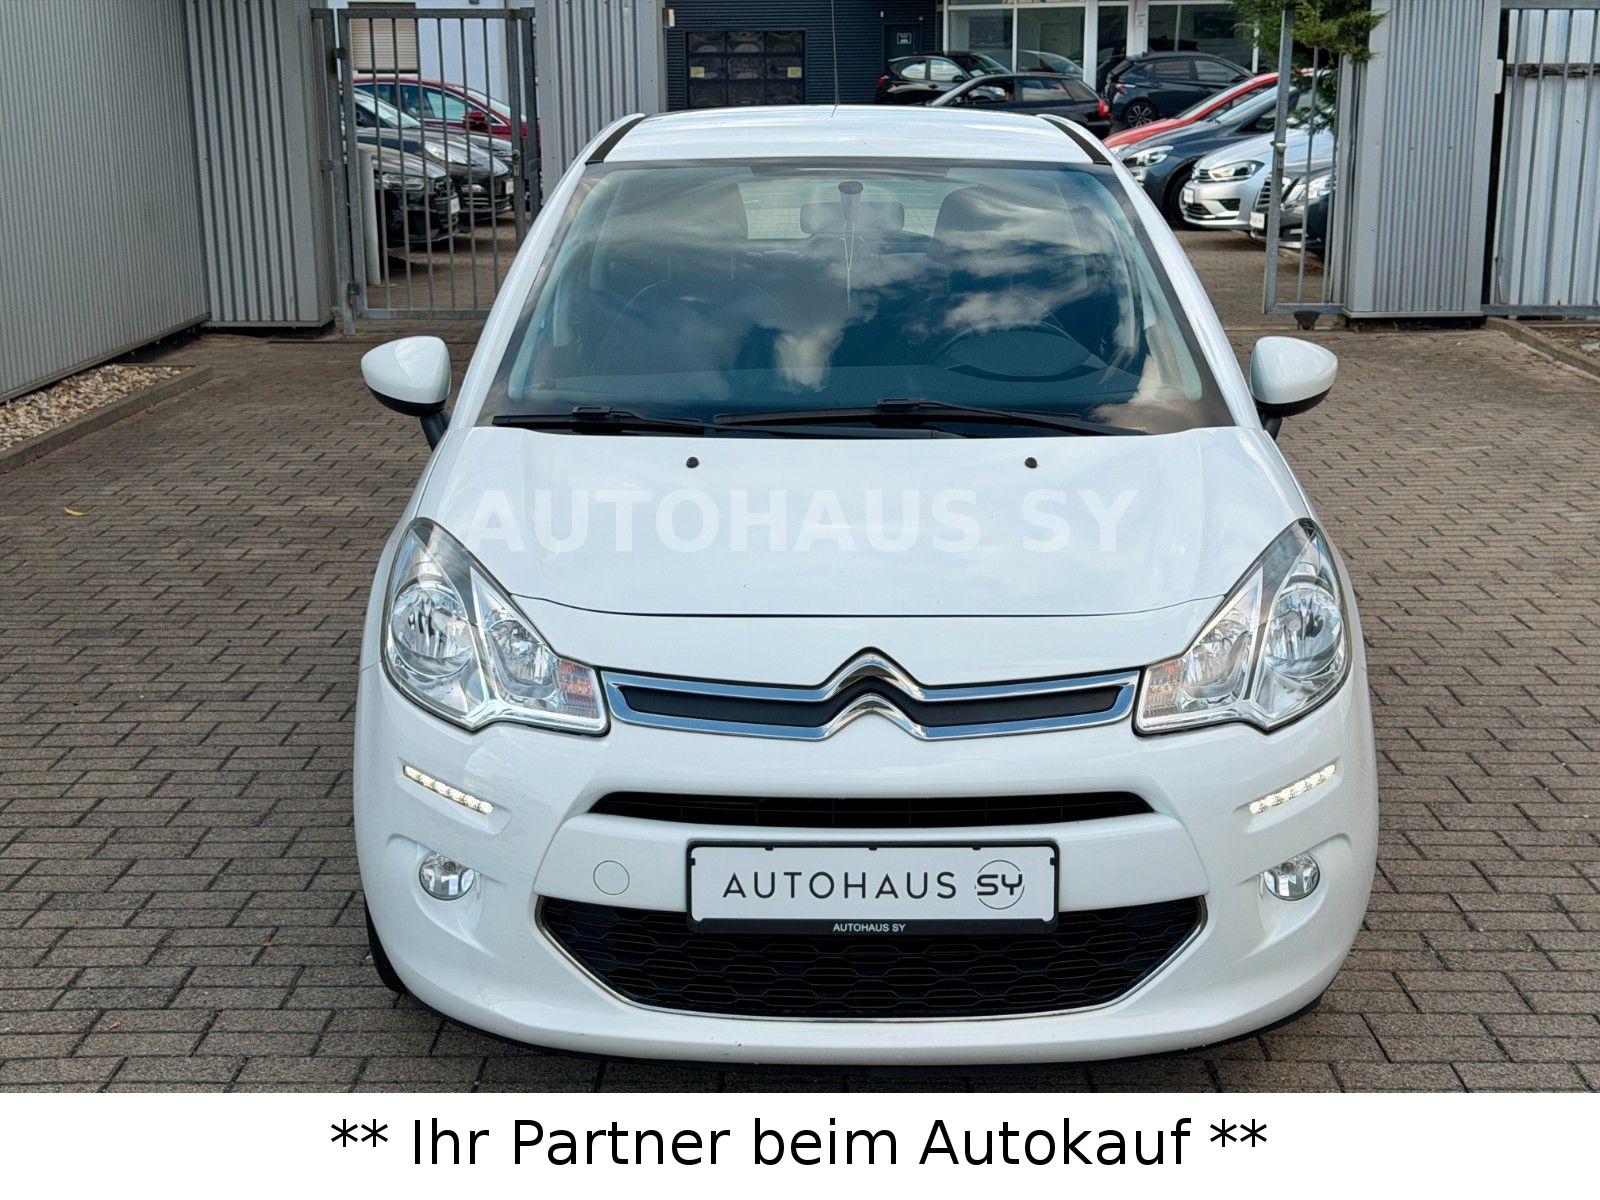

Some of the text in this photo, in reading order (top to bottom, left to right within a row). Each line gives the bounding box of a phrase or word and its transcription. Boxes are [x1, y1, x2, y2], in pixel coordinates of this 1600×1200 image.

[722, 871, 1024, 900] AUTOHAUS SY
[832, 922, 906, 933] AUTOHAUS SY
